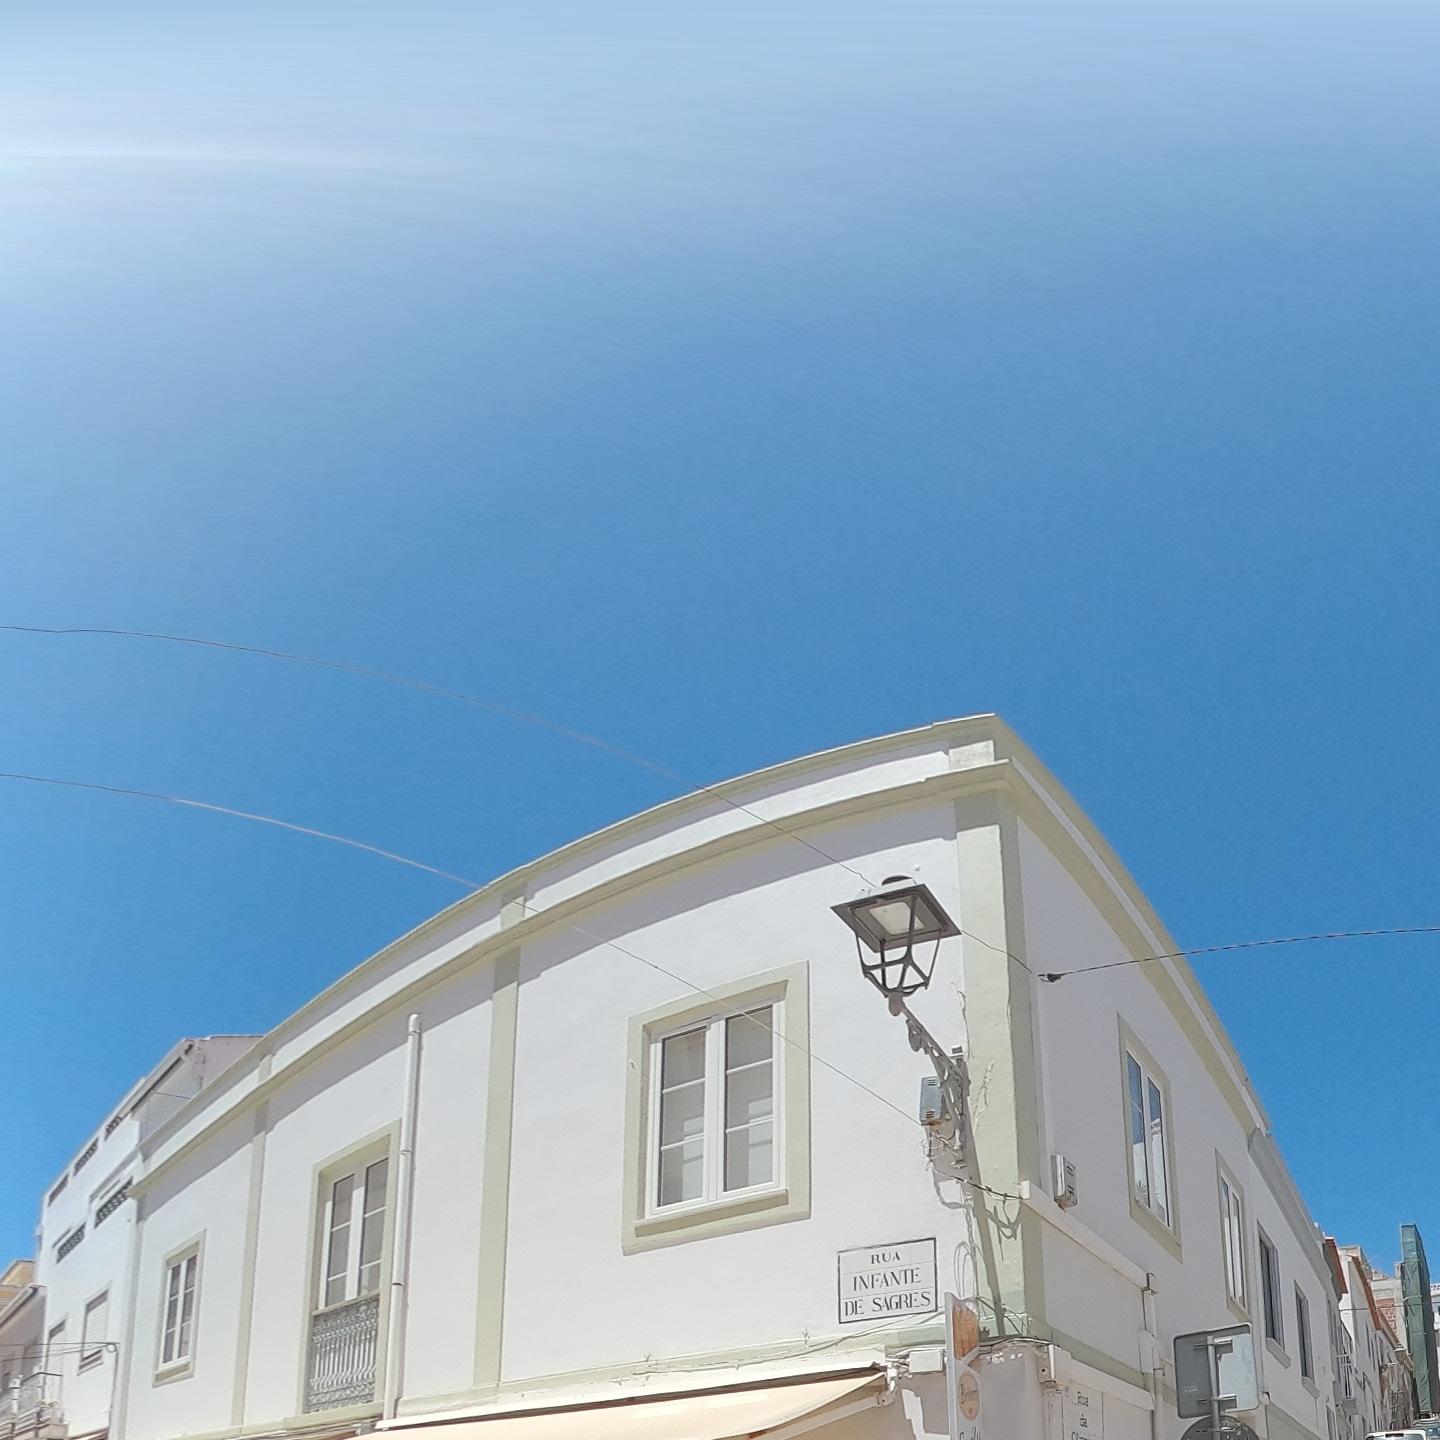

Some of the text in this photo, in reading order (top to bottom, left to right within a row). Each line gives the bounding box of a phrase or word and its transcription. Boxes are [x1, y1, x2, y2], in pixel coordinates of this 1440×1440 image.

[871, 1251, 901, 1265] RUA
[853, 1267, 922, 1292] INFANTE
[845, 1291, 931, 1316] DE SAGRES
